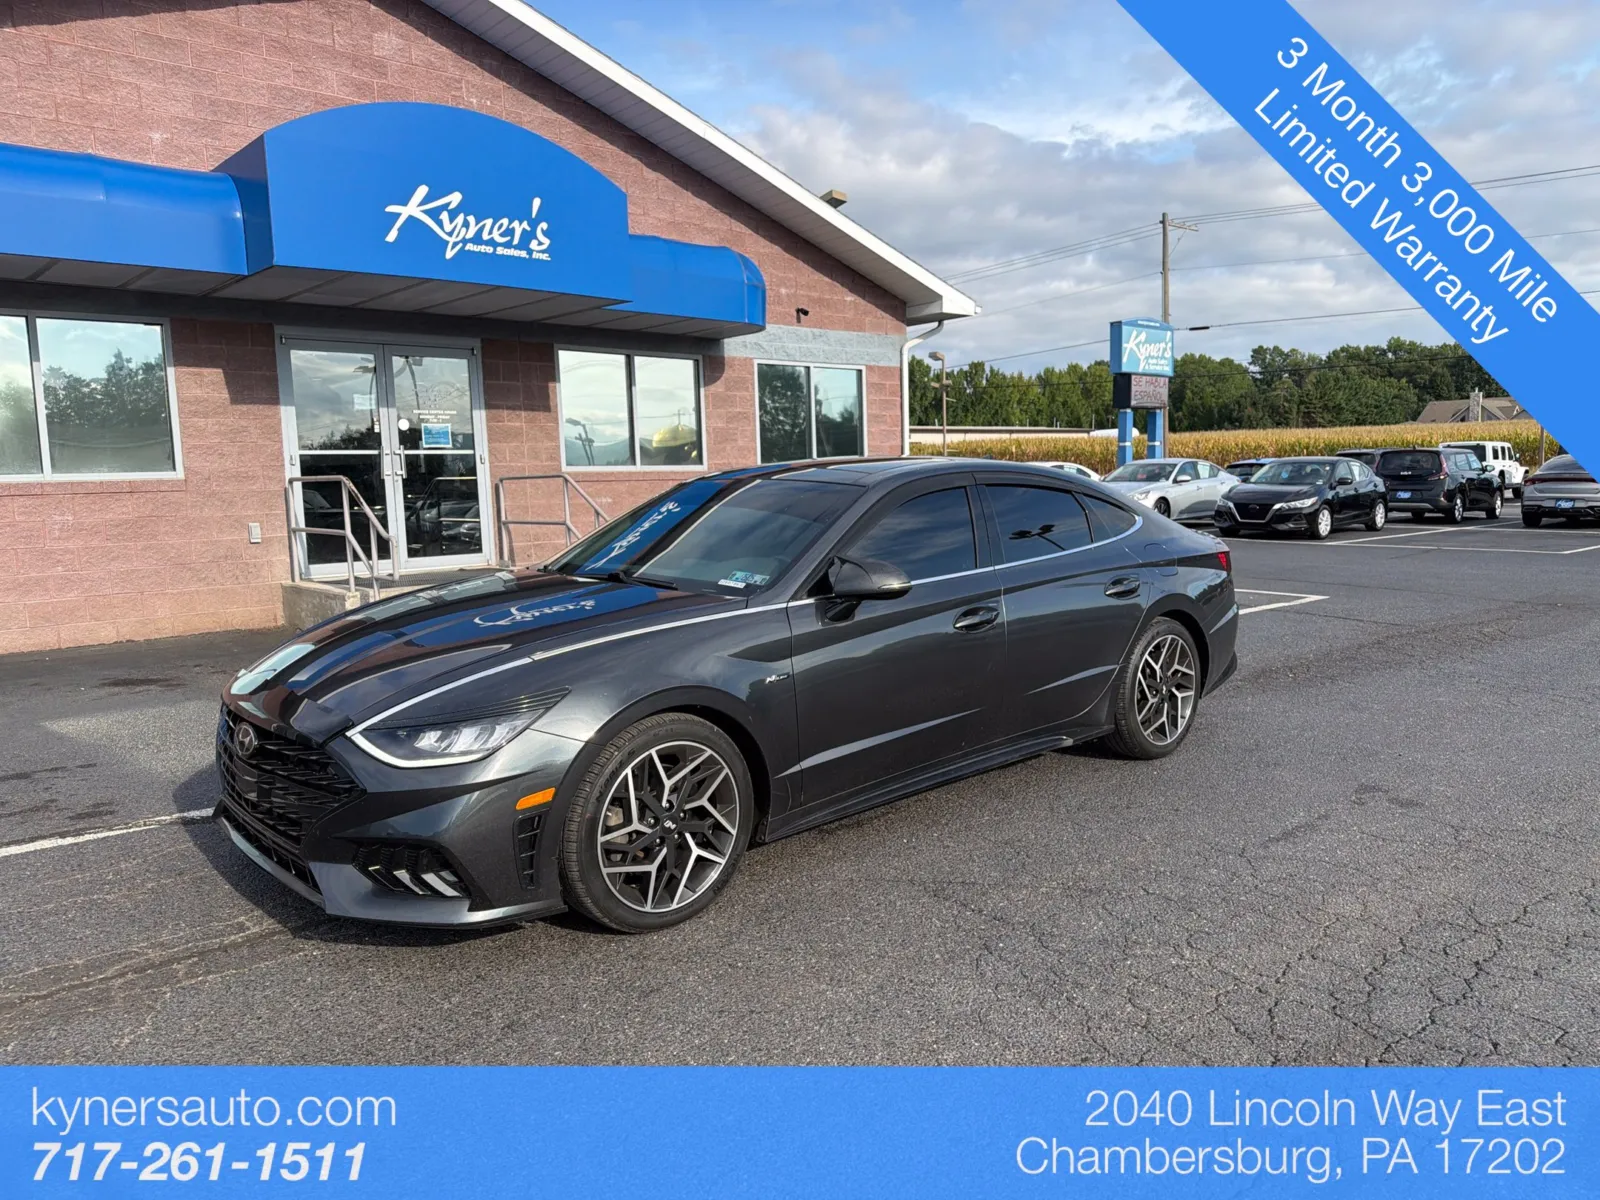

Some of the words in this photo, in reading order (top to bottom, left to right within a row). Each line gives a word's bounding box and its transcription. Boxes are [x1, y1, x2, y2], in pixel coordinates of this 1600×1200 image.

[384, 184, 551, 260] Kyner's
[464, 242, 494, 254] Auto
[495, 246, 530, 259] Sales,
[532, 251, 551, 261] Inc.
[1122, 328, 1172, 372] Kyner's
[1133, 376, 1143, 387] SE
[1145, 377, 1167, 389] HABLA
